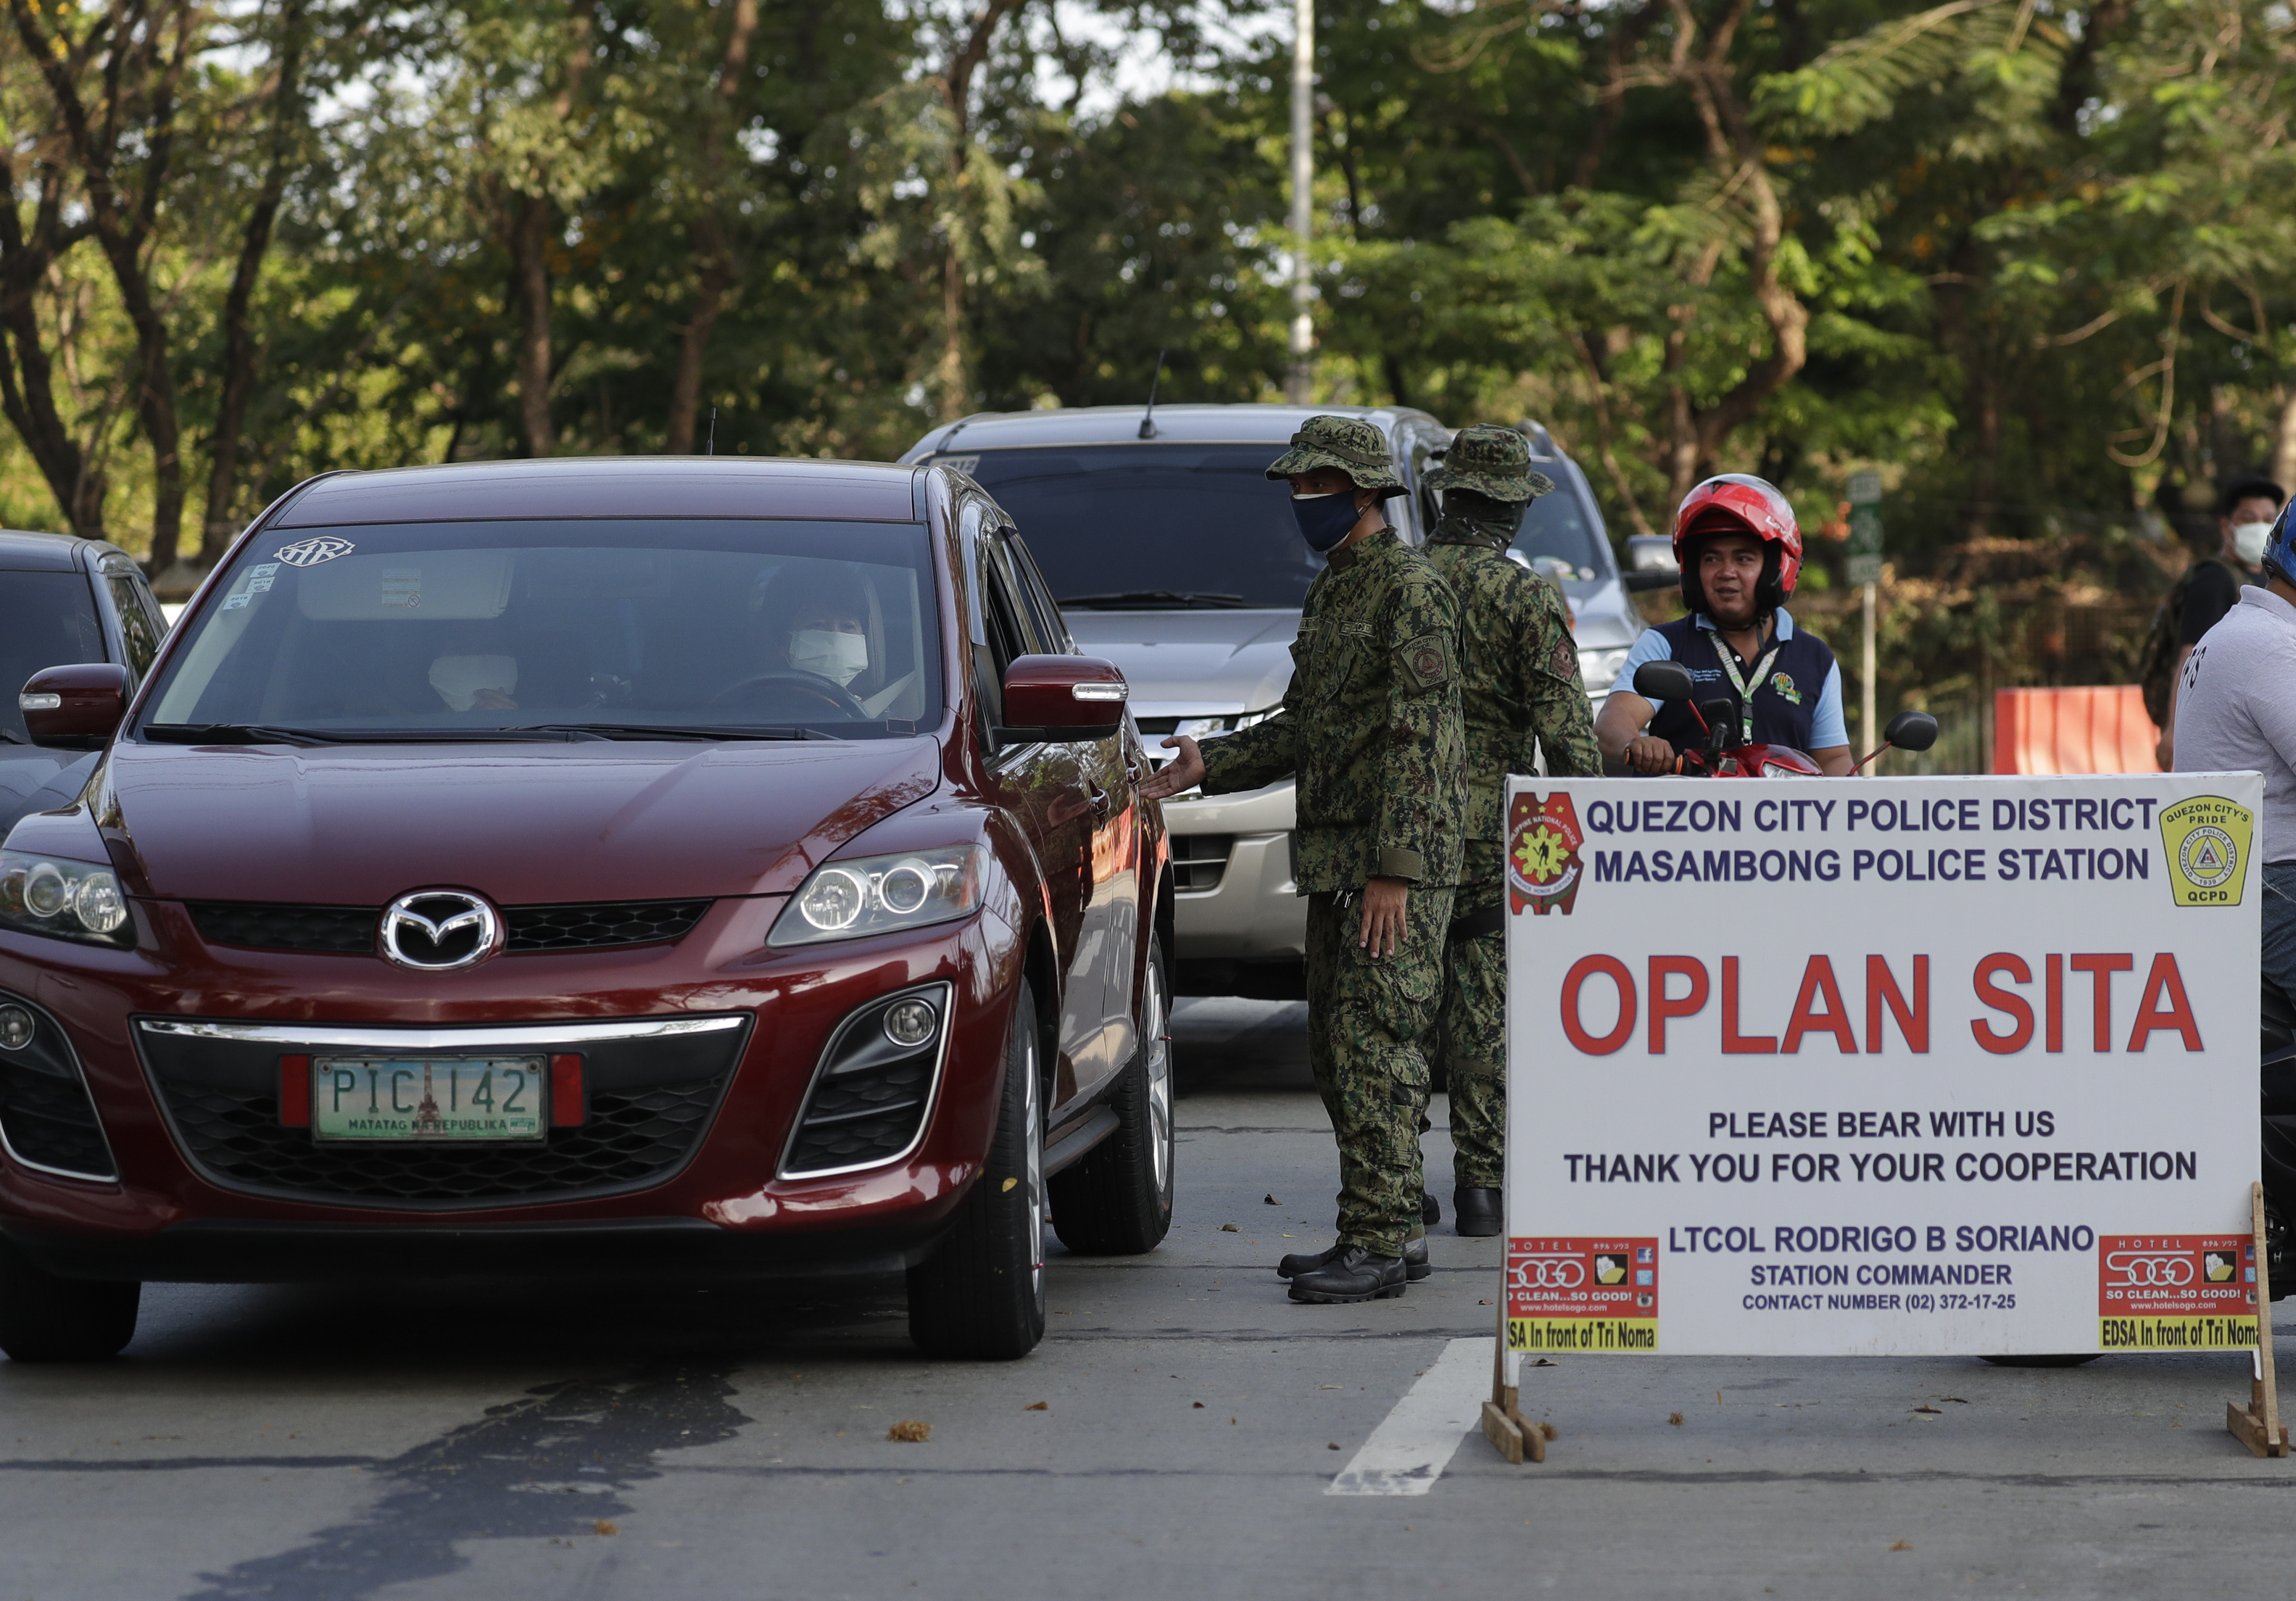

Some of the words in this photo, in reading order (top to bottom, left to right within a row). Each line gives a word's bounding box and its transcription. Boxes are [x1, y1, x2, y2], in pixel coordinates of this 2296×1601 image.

[1402, 639, 1422, 654] QUEZON
[1412, 642, 1431, 652] PRIDE
[1425, 675, 1443, 685] QCPD
[1586, 799, 1741, 834] QUEZON
[1754, 799, 1837, 833] CITY
[1847, 799, 1981, 832] POLICE
[1992, 797, 2158, 831] DISTRICT
[2166, 804, 2211, 823] QUEZON
[2215, 804, 2250, 822] CITY'S
[2189, 815, 2227, 824] PRIDE
[1509, 818, 1533, 847] HILIPPINE
[1533, 815, 1562, 828] NATIONAL
[1562, 823, 1578, 847] POLICE
[2187, 831, 2200, 845] CITY
[2202, 828, 2227, 842] POLICE
[1595, 849, 1841, 883] MASAMBONG
[1853, 849, 1986, 882] POLICE
[1997, 847, 2149, 881] STATION
[2181, 846, 2194, 878] QUEZON
[2223, 842, 2234, 878] DISTRICT
[1513, 876, 1532, 891] SERVICE
[1554, 876, 1572, 891] JUSTICE
[2188, 891, 2228, 902] QCPD
[1559, 953, 1930, 1057] OPLAN
[1970, 952, 2205, 1056] SITA
[333, 1068, 415, 1113] PIC
[449, 1068, 526, 1113] 142
[348, 1119, 407, 1131] MATATAG
[412, 1119, 428, 1131] NA
[434, 1118, 507, 1131] REPUBLIKA
[1709, 1111, 1828, 1139] PLEASE
[1837, 1111, 1922, 1138] BEAR
[1928, 1111, 2005, 1138] WITH
[2015, 1110, 2055, 1138] US
[1563, 1154, 1680, 1183] THANK
[1688, 1153, 1760, 1183] YOU
[1772, 1153, 1841, 1183] FOR
[1849, 1152, 1946, 1183] YOUR
[1955, 1151, 2197, 1182] COOPERATION
[1509, 1242, 1572, 1251] HOTEL
[1669, 1226, 1766, 1253] LTCOL
[1775, 1226, 1917, 1253] RODRIGO
[1926, 1226, 1947, 1252] B
[1955, 1225, 2094, 1252] SORIANO
[2118, 1239, 2182, 1249] HOTEL
[1751, 1265, 1849, 1286] STATION
[1856, 1264, 2013, 1286] COMMANDER
[2106, 1250, 2195, 1286] SOGO
[1517, 1292, 1588, 1302] CLEAN...SO
[1591, 1292, 1633, 1302] GOOD!
[1742, 1294, 1824, 1310] CONTACT
[1828, 1294, 1902, 1310] NUMBER
[1905, 1294, 1936, 1313] (02)
[1939, 1294, 2016, 1310] 372-17-25
[2106, 1289, 2123, 1299] SO
[2127, 1289, 2197, 1299] CLEAN...SO
[2201, 1289, 2241, 1299] GOOD!
[1520, 1304, 1608, 1313] www.hotelsogo.com
[2130, 1302, 2217, 1310] www.hotelsogo.com
[1509, 1321, 1527, 1348] SA
[1530, 1321, 1543, 1348] In
[1546, 1321, 1577, 1348] front
[1580, 1321, 1594, 1348] of
[1596, 1321, 1614, 1348] Tri
[1618, 1321, 1655, 1349] Noma
[2102, 1319, 2137, 1347] EDSA
[2141, 1319, 2153, 1346] In
[2156, 1319, 2187, 1346] front
[2190, 1318, 2204, 1346] of
[2206, 1319, 2224, 1346] Tri
